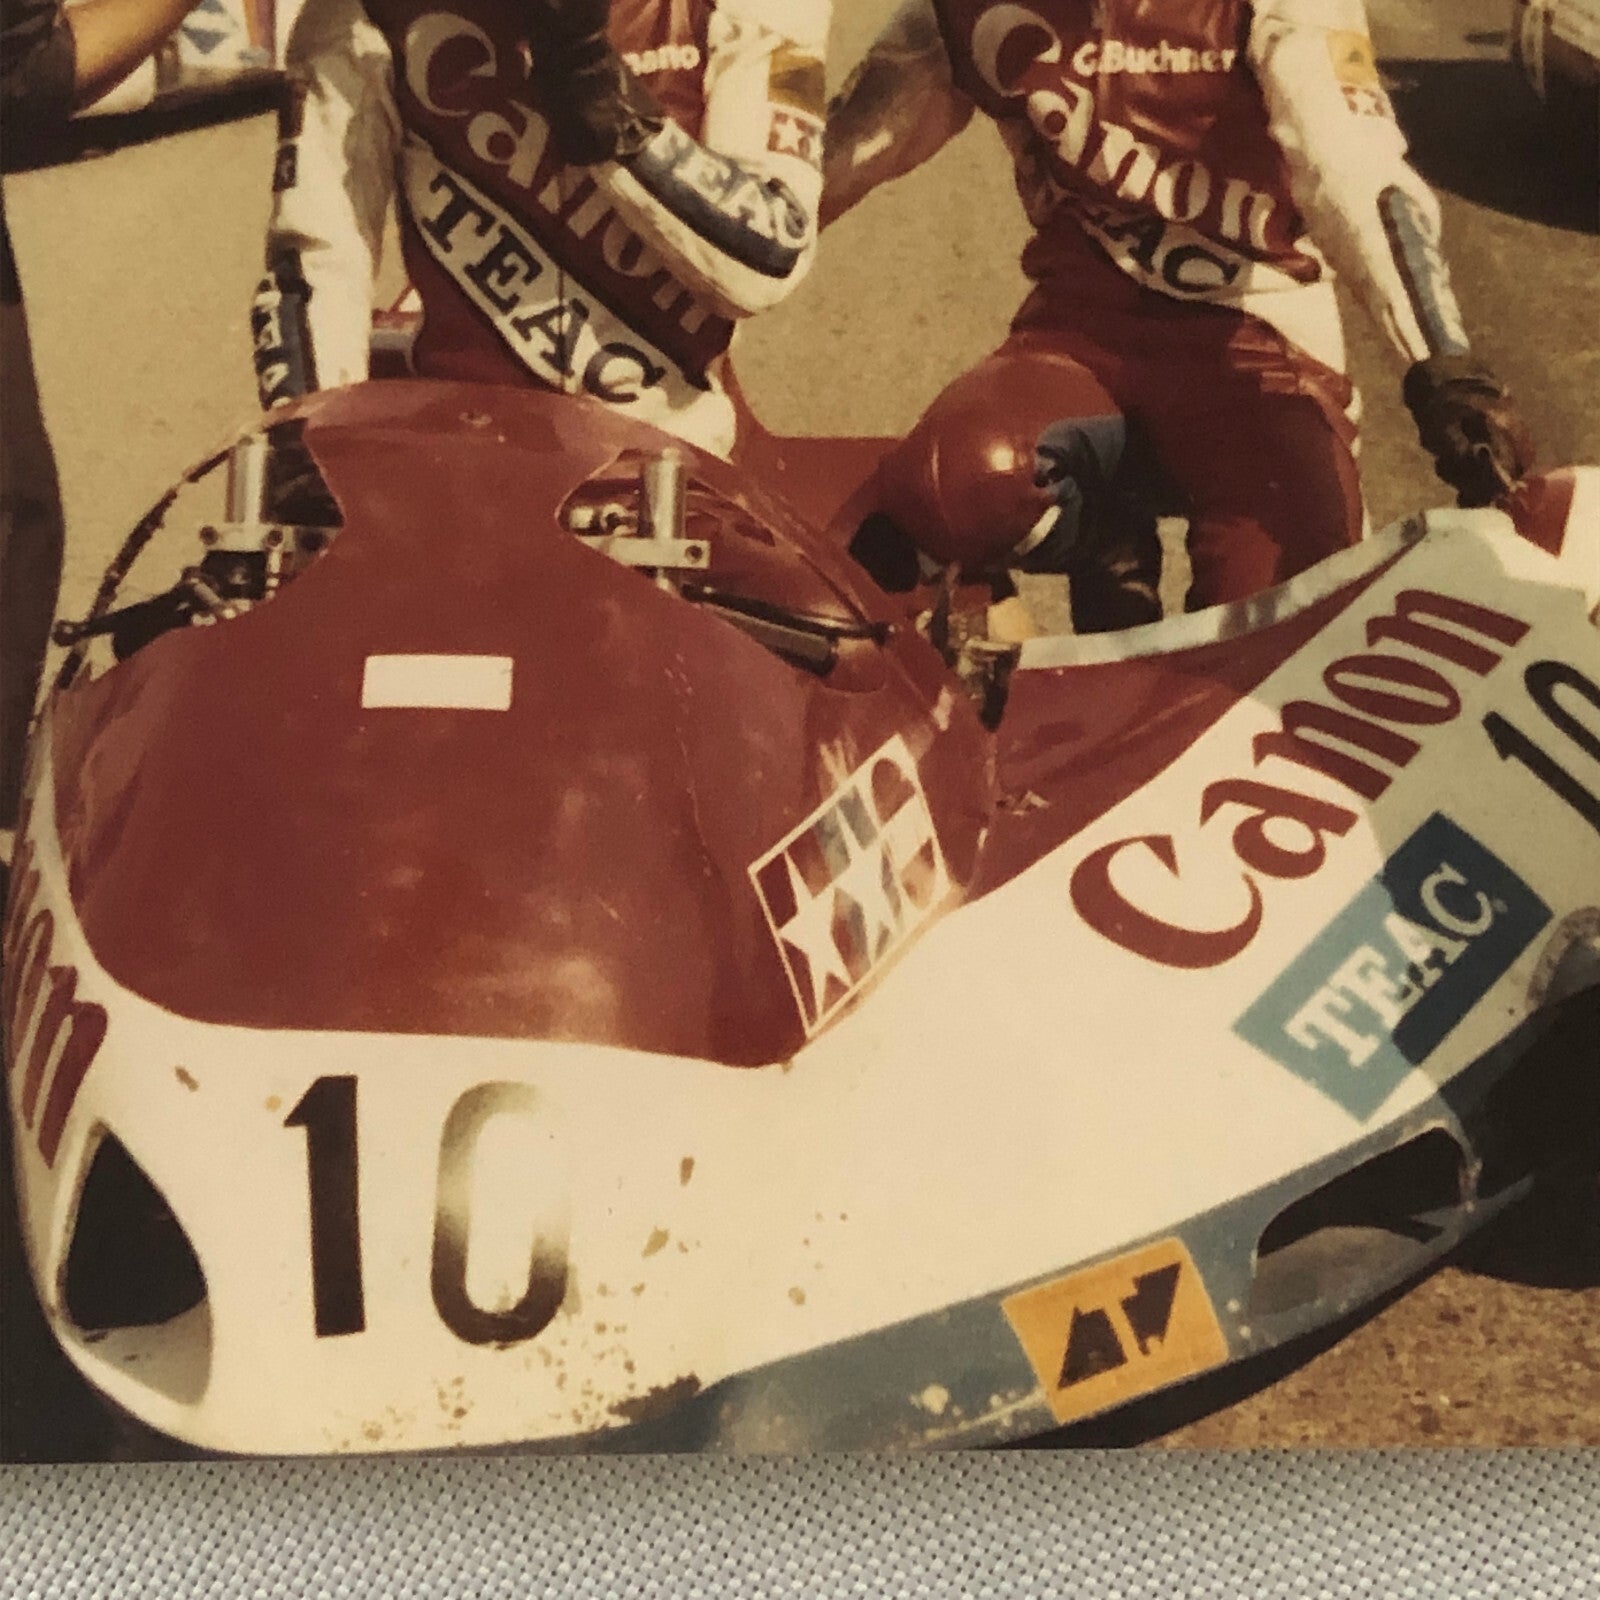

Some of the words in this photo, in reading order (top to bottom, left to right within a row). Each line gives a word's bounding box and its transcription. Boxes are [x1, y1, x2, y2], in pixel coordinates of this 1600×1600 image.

[972, 3, 1277, 250] Canon
[424, 172, 666, 403] TEAC
[1069, 589, 1532, 969] Canon
[1284, 861, 1495, 1067] TEAC
[284, 1073, 572, 1349] 10
